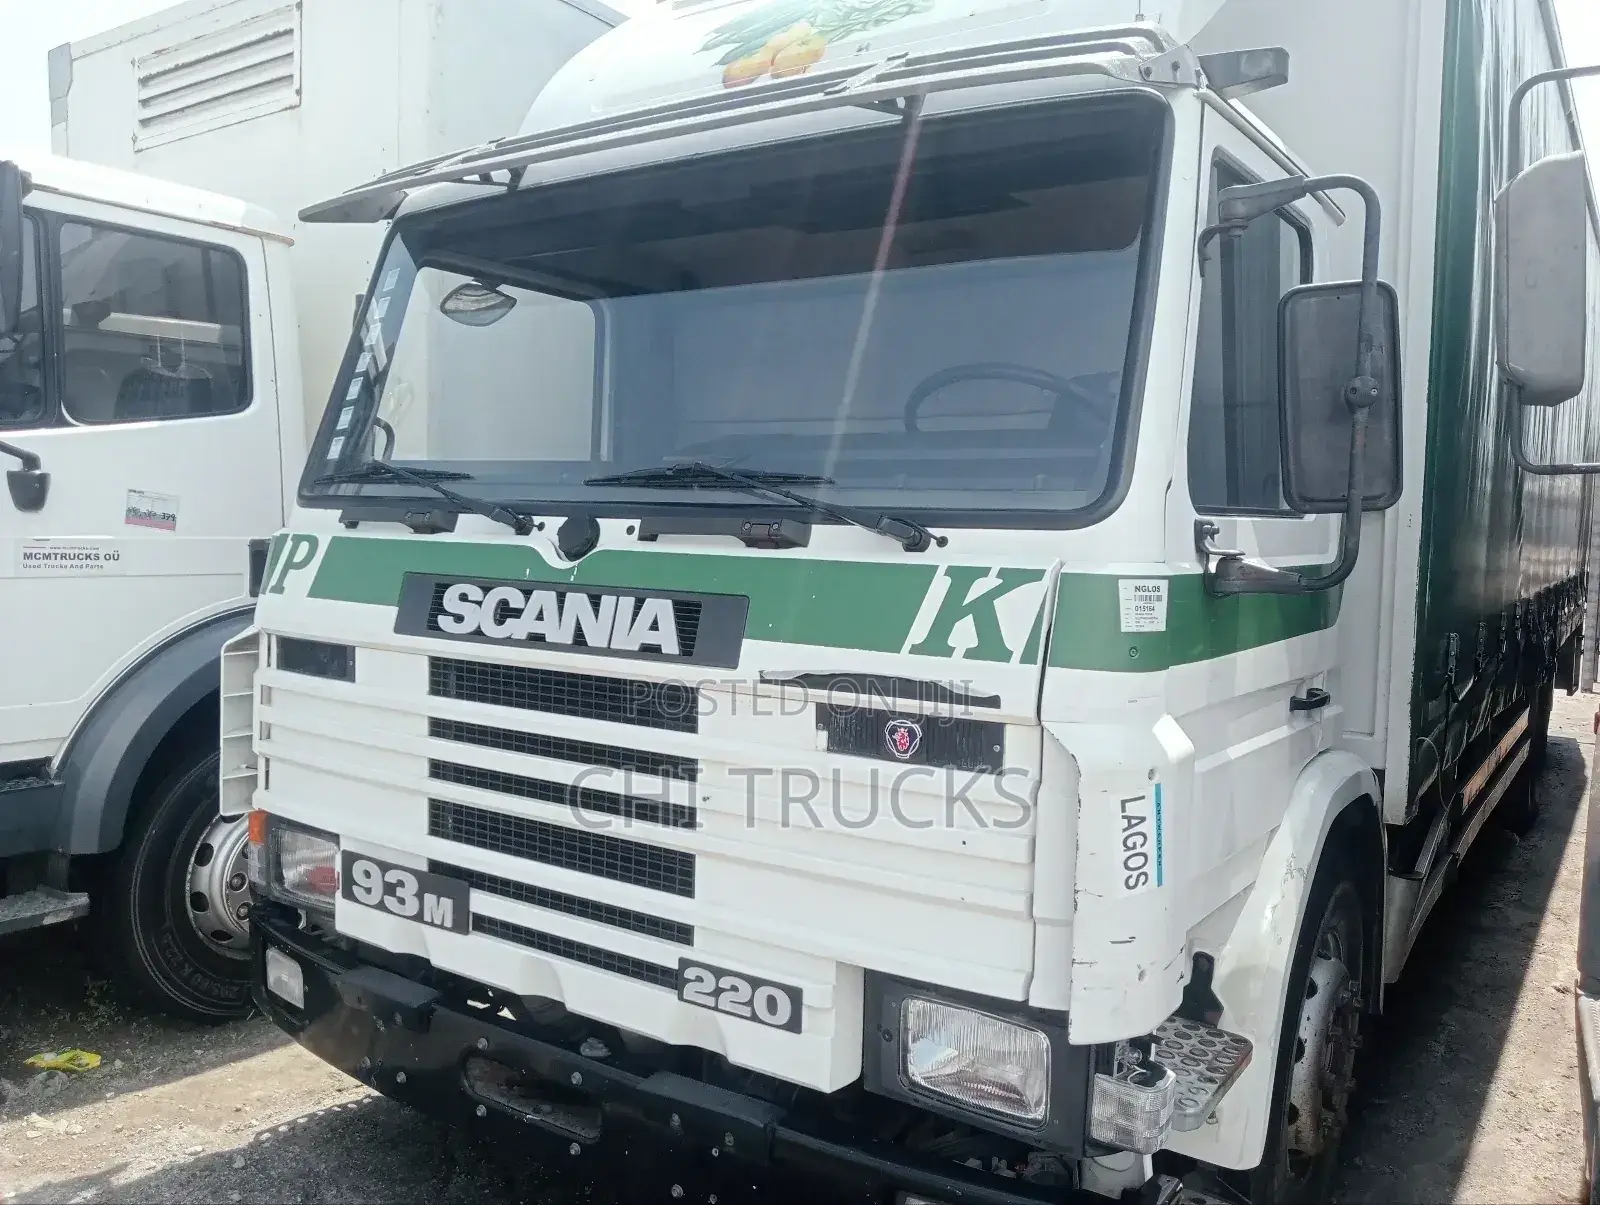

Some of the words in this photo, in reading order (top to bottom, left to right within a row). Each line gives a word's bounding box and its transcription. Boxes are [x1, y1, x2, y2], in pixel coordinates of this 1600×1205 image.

[23, 552, 100, 561] MCMTRUCKS
[104, 550, 120, 561] OÜ
[269, 534, 319, 595] P
[437, 583, 679, 655] SCANIA
[1120, 795, 1149, 891] LAGOS
[682, 965, 792, 1026] 220
